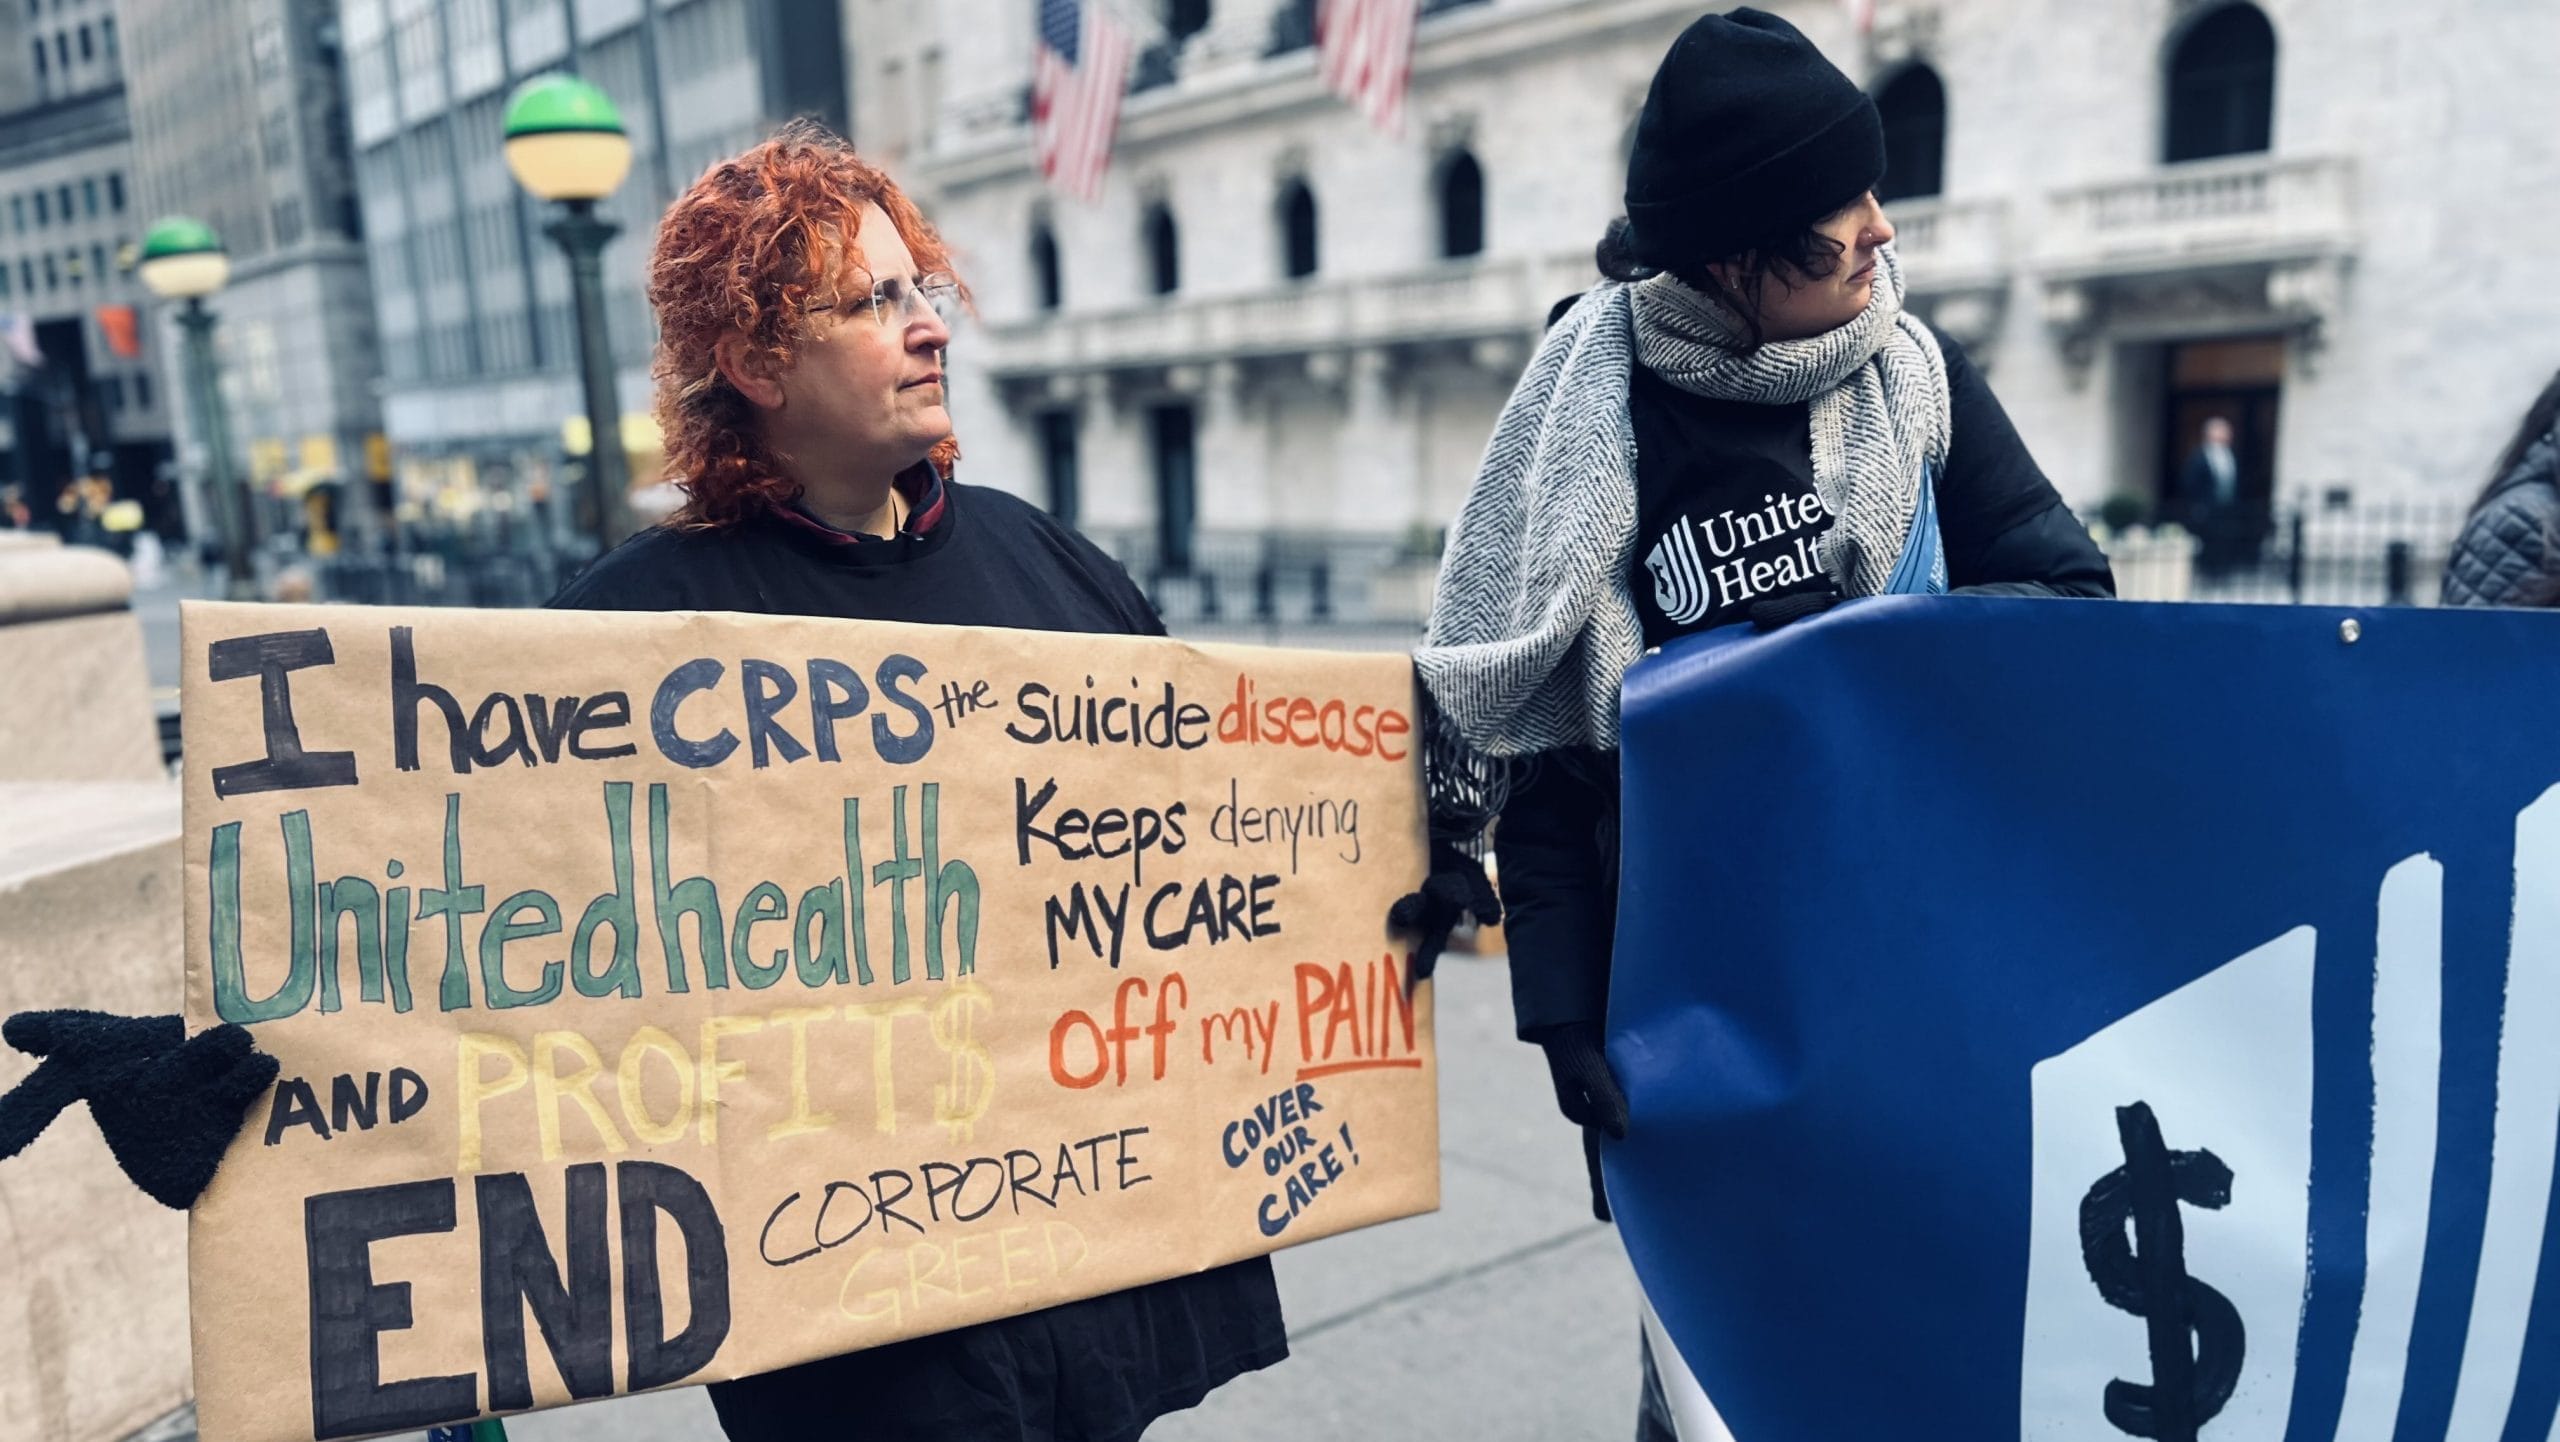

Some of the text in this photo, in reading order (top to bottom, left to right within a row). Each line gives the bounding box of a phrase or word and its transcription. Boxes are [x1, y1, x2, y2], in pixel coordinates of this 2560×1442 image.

[1711, 536, 1826, 607] Healt
[209, 627, 358, 800] I
[389, 626, 638, 774] have
[650, 653, 935, 769] CRPS
[934, 676, 998, 729] the
[1217, 672, 1410, 761] disease
[1014, 776, 1360, 886] Keeps denying
[210, 780, 980, 1024] Unitedhealth
[1045, 874, 1280, 970] MY CARE
[264, 965, 995, 1172] AND PROFIT$
[1201, 1000, 1279, 1074] my
[1294, 952, 1415, 1062] PAIN
[1222, 1082, 1323, 1168] COVER
[1258, 1122, 1360, 1236] CARE!
[1264, 1126, 1316, 1176] OUR
[304, 1127, 1152, 1442] END CORPORATE
[838, 1221, 1088, 1325] GREED
